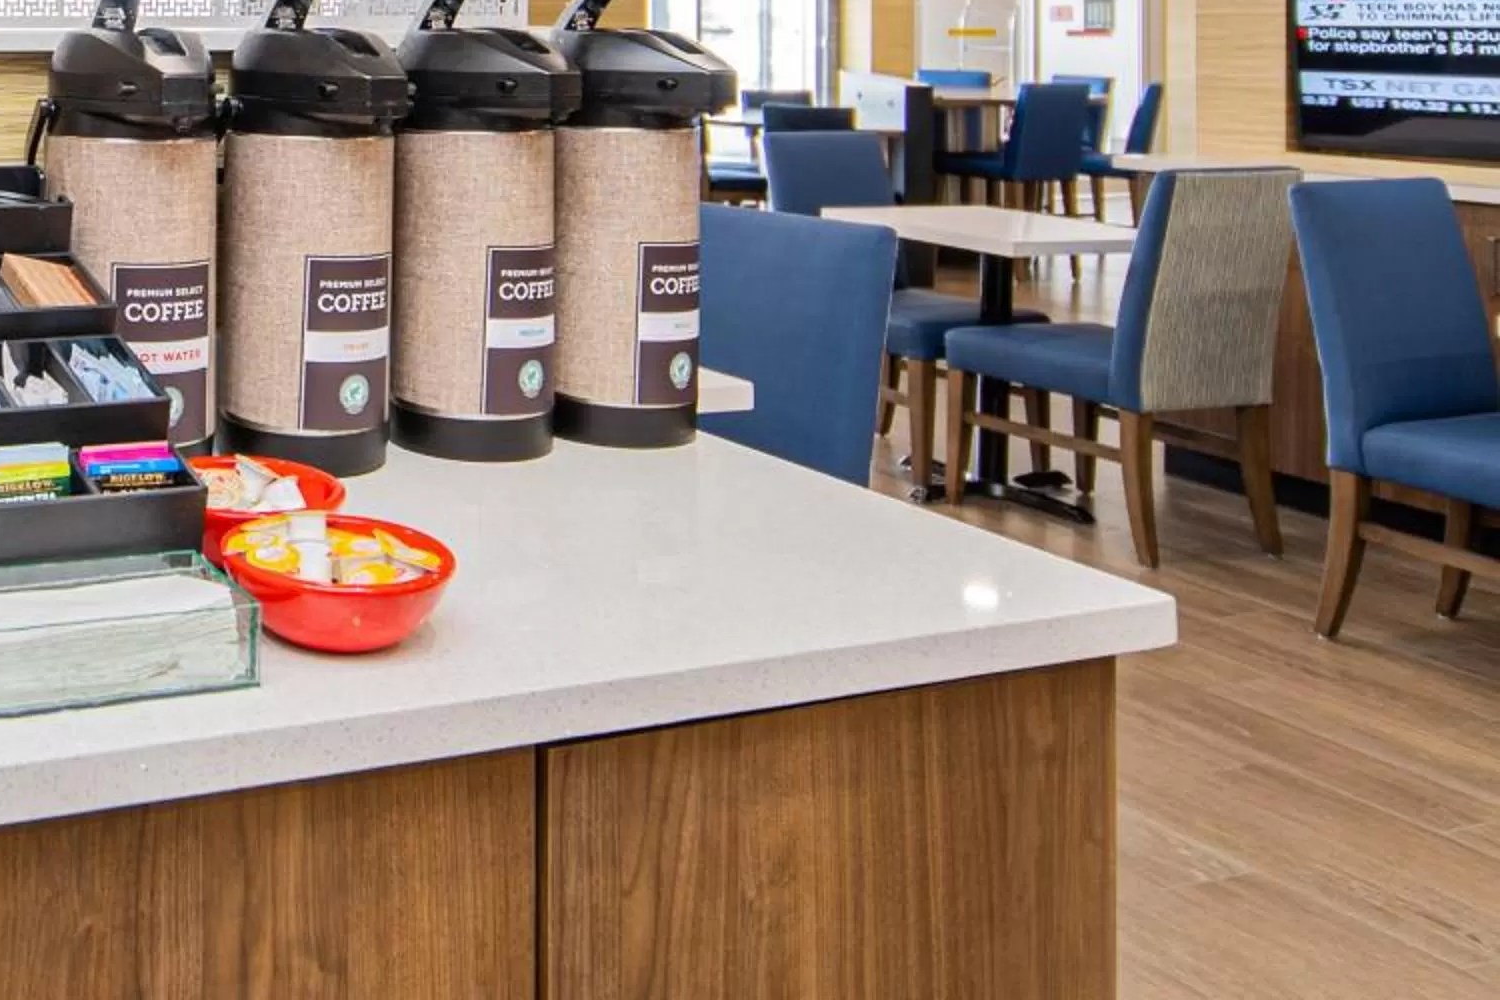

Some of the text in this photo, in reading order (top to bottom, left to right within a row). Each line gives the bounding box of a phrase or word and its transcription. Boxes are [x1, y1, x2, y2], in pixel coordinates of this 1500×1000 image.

[1357, 3, 1398, 11] TEEN
[1403, 3, 1437, 11] BOY
[1443, 3, 1477, 11] HAS
[1383, 12, 1461, 21] CRIMINAL
[1308, 27, 1357, 41] Police
[1360, 30, 1391, 43] say
[1394, 28, 1449, 41] teen's
[1308, 41, 1330, 52] for
[1334, 42, 1448, 56] stepbrother's
[1324, 77, 1377, 91] TSX
[1385, 80, 1441, 94] NET
[126, 285, 204, 297] PREMIUM SELECT
[319, 279, 363, 289] PREMIUM
[650, 275, 699, 295] COFFE
[317, 290, 387, 313] COFFEE
[124, 299, 204, 323] COFFEE
